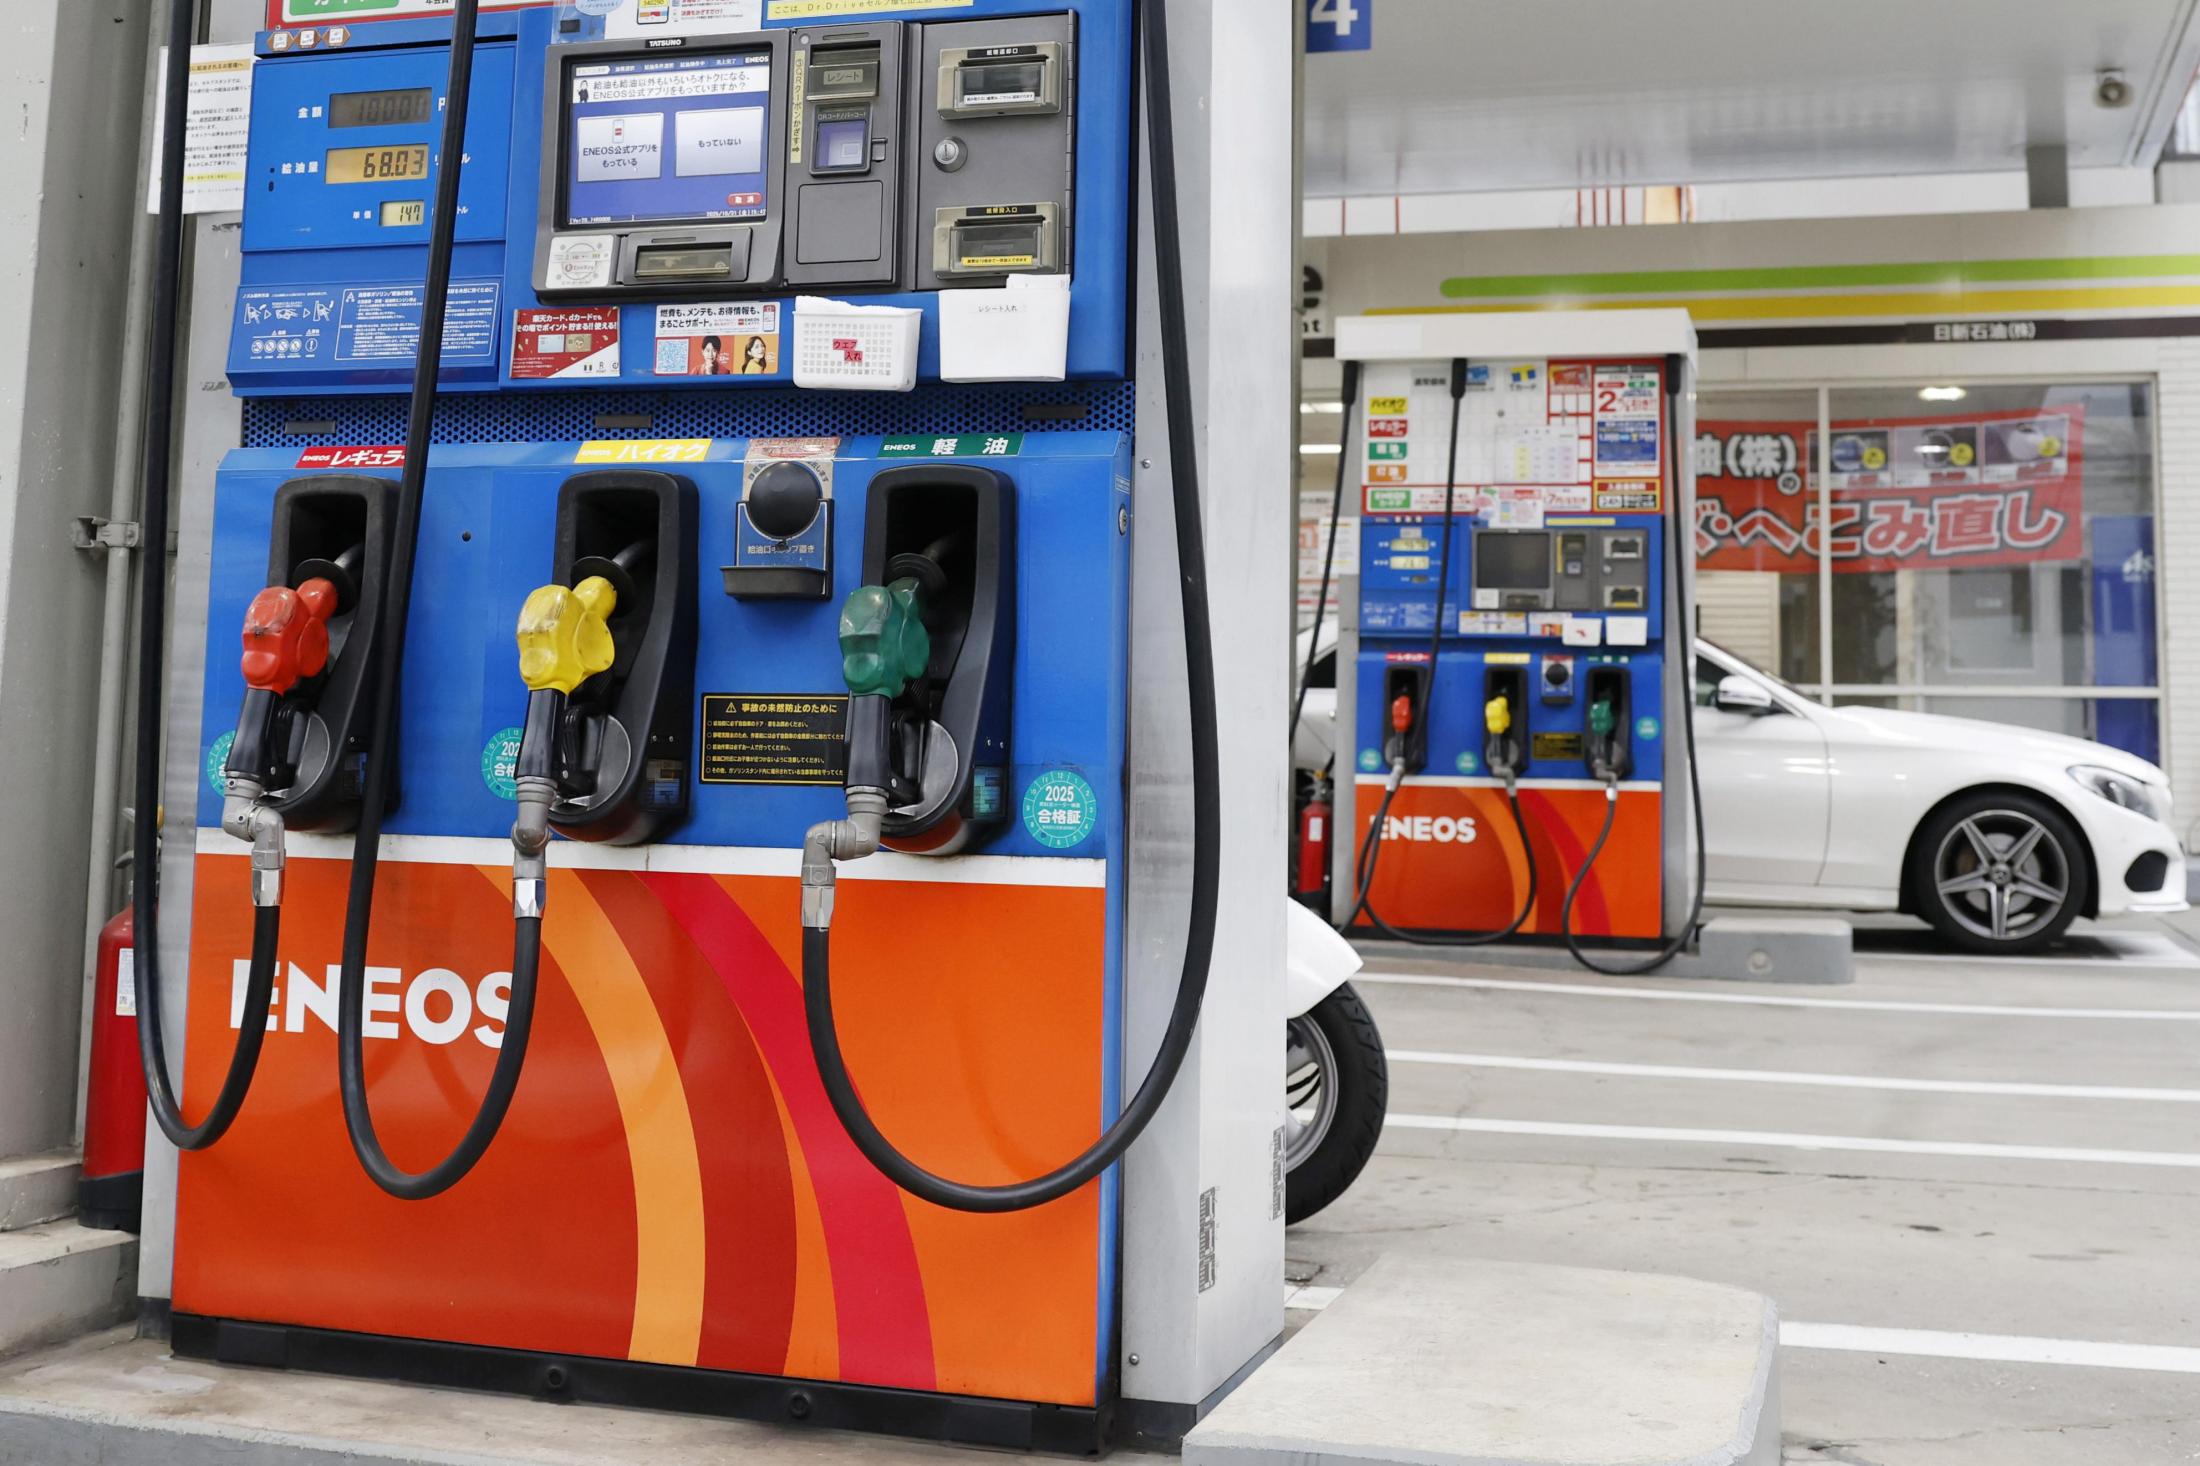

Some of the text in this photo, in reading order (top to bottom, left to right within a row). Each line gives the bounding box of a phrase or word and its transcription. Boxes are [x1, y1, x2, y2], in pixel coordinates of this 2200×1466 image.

[649, 39, 681, 47] TATSUNO
[745, 56, 769, 64] ENEOS
[298, 106, 322, 119] 金額
[698, 137, 742, 148] もっていない
[583, 144, 658, 157] ENEOS公式アプリを
[281, 161, 319, 175] 給油量
[363, 150, 426, 178] 68.03
[602, 158, 638, 168] もっている
[399, 205, 421, 222] 147
[659, 307, 760, 318] 燃費も、メンテも、お得情報も、
[978, 304, 1017, 313] レシート入れ
[615, 443, 705, 461] ハイオク
[742, 702, 838, 714] 事故の未然防止のために
[501, 741, 521, 757] 202
[493, 762, 517, 778] 合格
[1045, 785, 1075, 802] 2025
[1037, 808, 1081, 825] 合格証
[230, 959, 513, 1049] ENEOS
